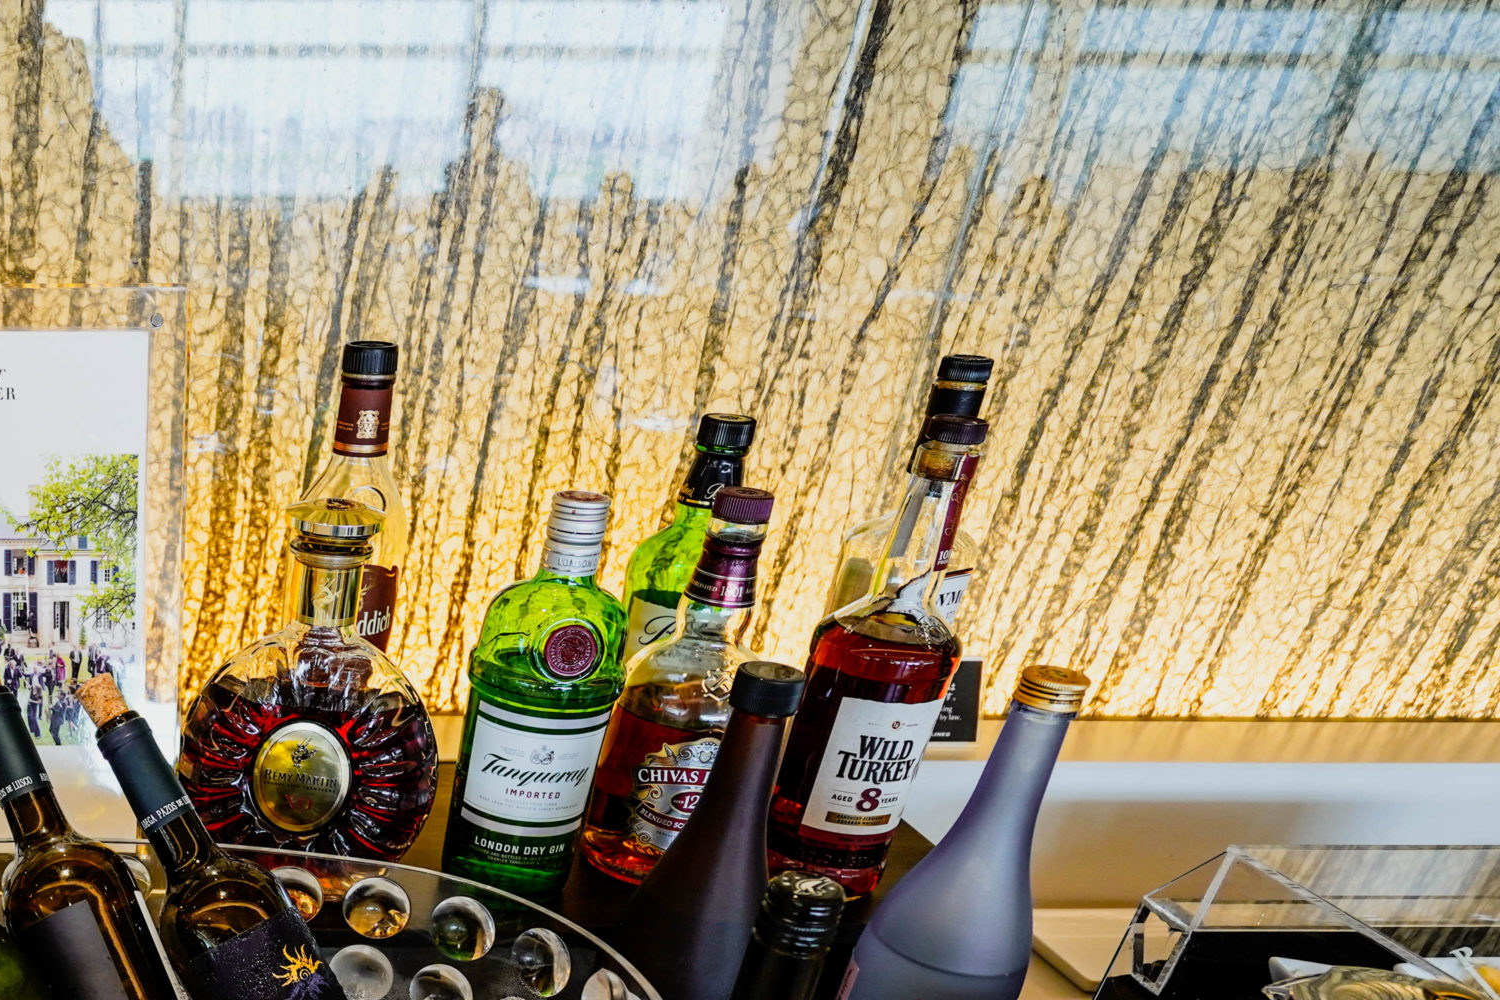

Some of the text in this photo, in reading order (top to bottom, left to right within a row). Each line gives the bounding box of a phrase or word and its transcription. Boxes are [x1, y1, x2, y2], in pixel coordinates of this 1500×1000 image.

[720, 584, 744, 598] 1801
[357, 605, 391, 636] ddich
[859, 735, 914, 761] WILD
[481, 753, 590, 788] Tanqueray
[637, 768, 700, 783] CHIVAS
[836, 750, 916, 785] TURKEY
[11, 775, 33, 792] LUSCO
[296, 770, 338, 788] MARTIN
[505, 787, 561, 800] IMPORTED
[683, 795, 700, 809] 12
[831, 788, 899, 812] AGED 8 YEARS
[156, 801, 178, 819] PAZOS
[639, 808, 673, 827] BLENDED
[474, 835, 519, 855] LONDON
[523, 846, 546, 856] DRY
[549, 843, 566, 854] GIN
